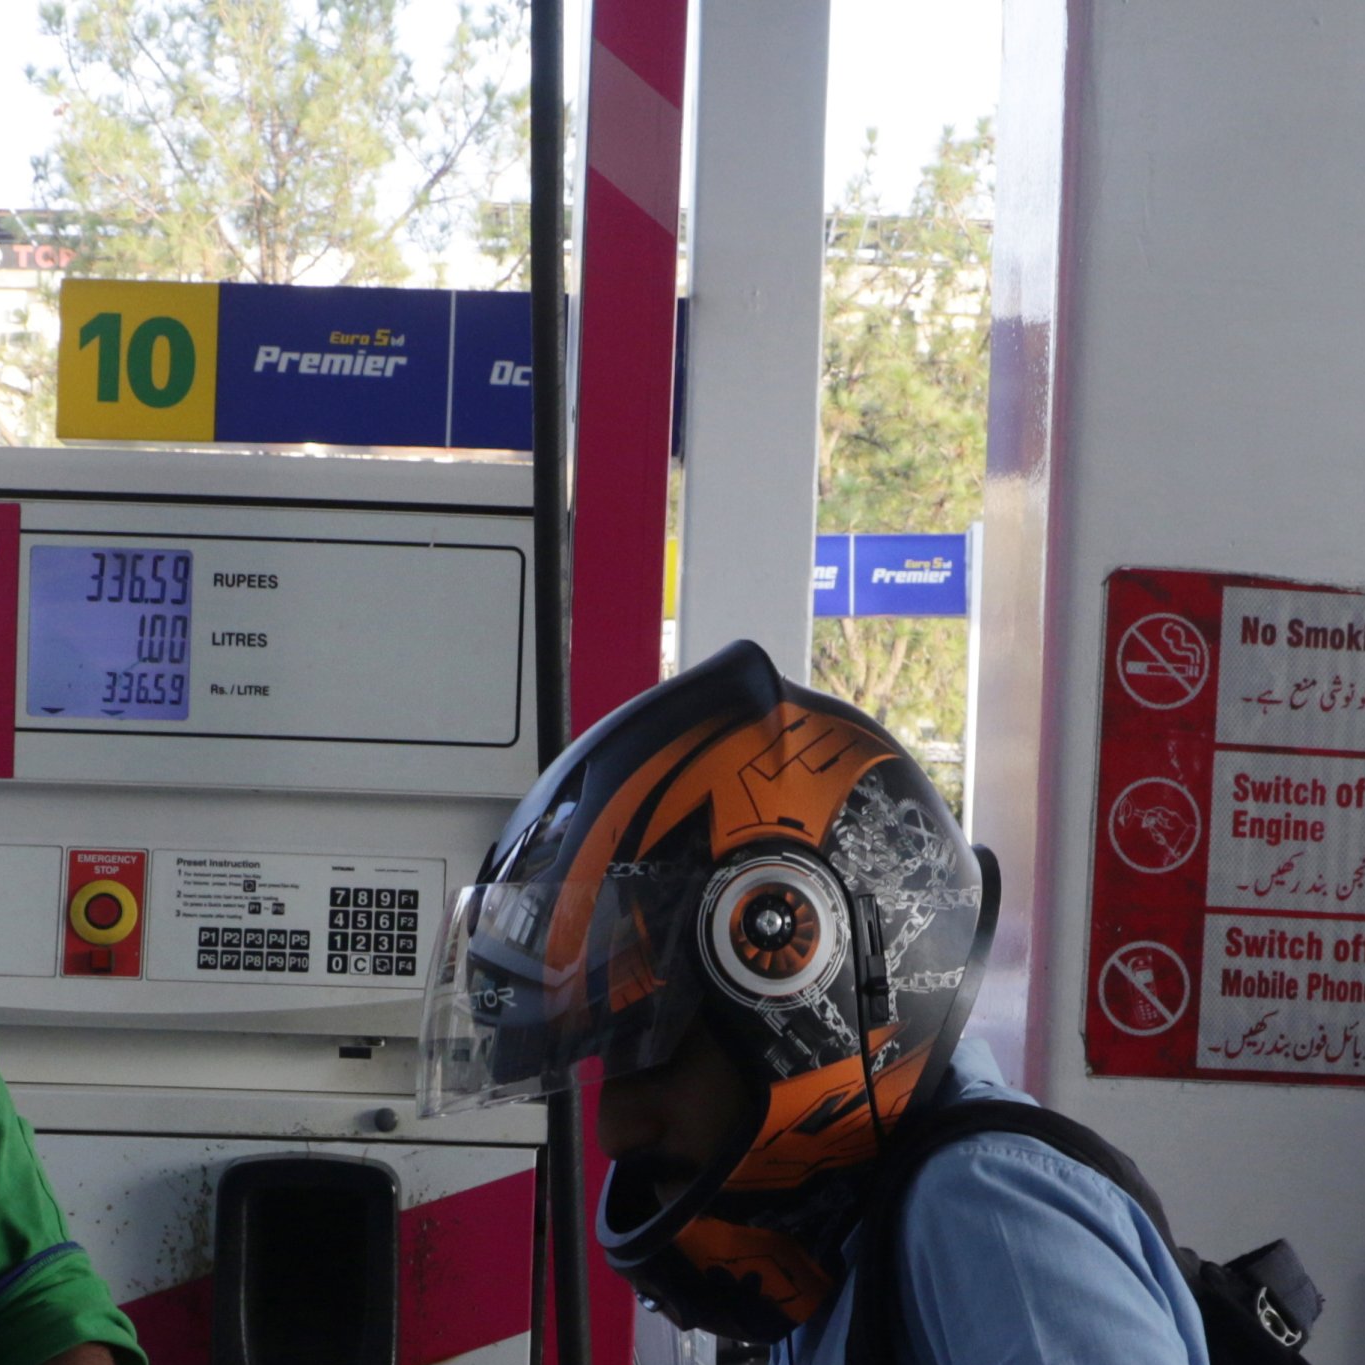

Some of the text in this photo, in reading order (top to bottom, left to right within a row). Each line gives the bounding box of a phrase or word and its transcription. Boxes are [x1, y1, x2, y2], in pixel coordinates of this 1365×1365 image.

[329, 328, 392, 347] Euro 5
[78, 312, 197, 409] 10
[253, 346, 407, 377] Premier
[489, 360, 533, 386] Oc
[86, 552, 191, 606] 336.59
[213, 573, 279, 589] RUPEES
[871, 567, 952, 584] Premier
[137, 614, 188, 663] 1.00
[211, 631, 268, 648] LITRES
[1241, 616, 1277, 646] No
[102, 671, 184, 705] 336.59
[210, 683, 228, 696] Rs.
[237, 685, 270, 696] LITRE
[1232, 772, 1327, 806] Switch
[1231, 809, 1325, 846] Engine
[77, 854, 138, 865] EMERGENCY
[176, 857, 261, 869] Preset Instruction
[94, 865, 120, 875] STOP
[336, 890, 414, 906] 7 8 9 F1
[334, 913, 414, 928] 4 5 6 F2
[201, 931, 308, 946] P1 P2 P3 P4 P5
[335, 935, 413, 950] 1 2 3 F3
[1225, 926, 1323, 960] Switch
[200, 954, 308, 968] P6 P7 P8 P9 P10
[332, 957, 412, 972] 0 C F4
[1220, 968, 1299, 1000] Mobile
